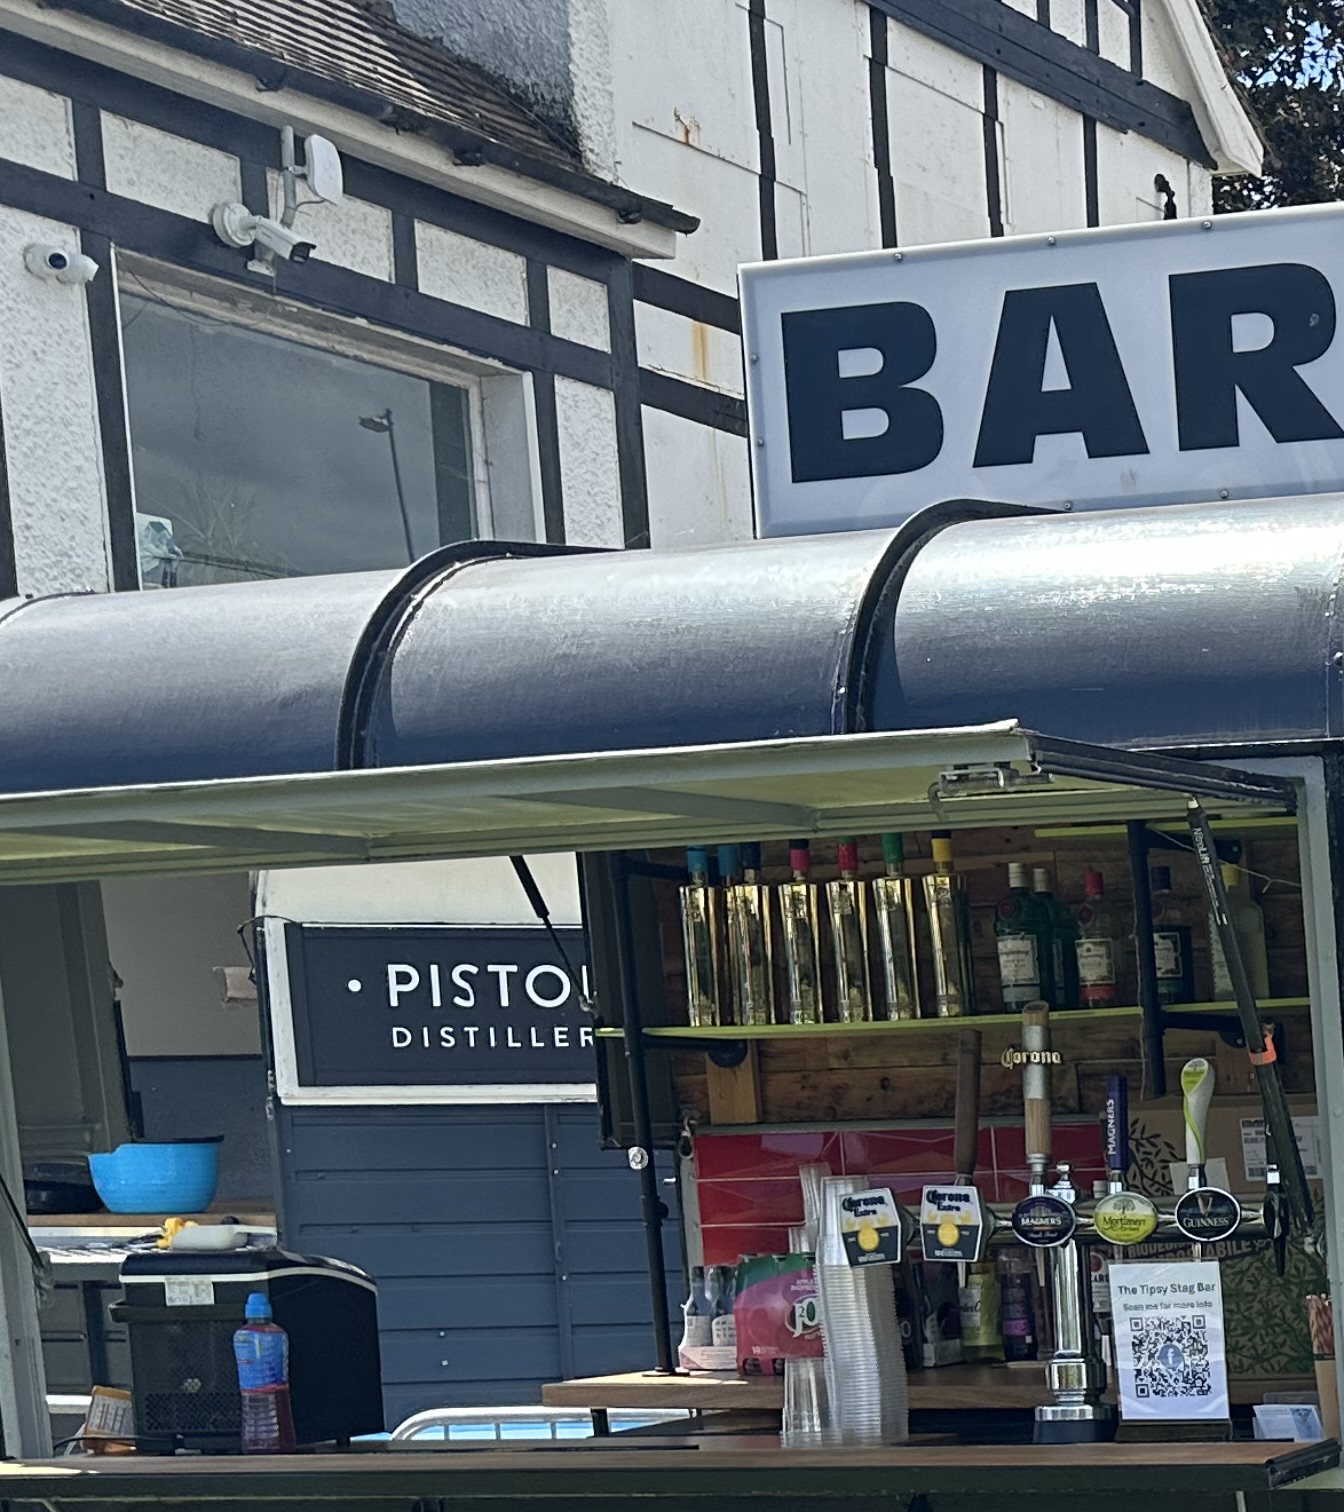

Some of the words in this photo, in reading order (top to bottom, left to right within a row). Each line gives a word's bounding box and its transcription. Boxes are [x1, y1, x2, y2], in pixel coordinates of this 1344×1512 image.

[1001, 1047, 1062, 1070] Corona
[1105, 1098, 1117, 1155] MAGNERS
[842, 1194, 886, 1212] Corona
[925, 1189, 971, 1205] Corona
[937, 1203, 961, 1212] Extra
[1020, 1217, 1062, 1226] MAGNERS
[1183, 1217, 1229, 1228] GUINNESS
[1118, 1285, 1137, 1295] The
[1139, 1284, 1168, 1296] Tipsy
[1170, 1283, 1195, 1295] Stag
[1198, 1282, 1216, 1292] Bar
